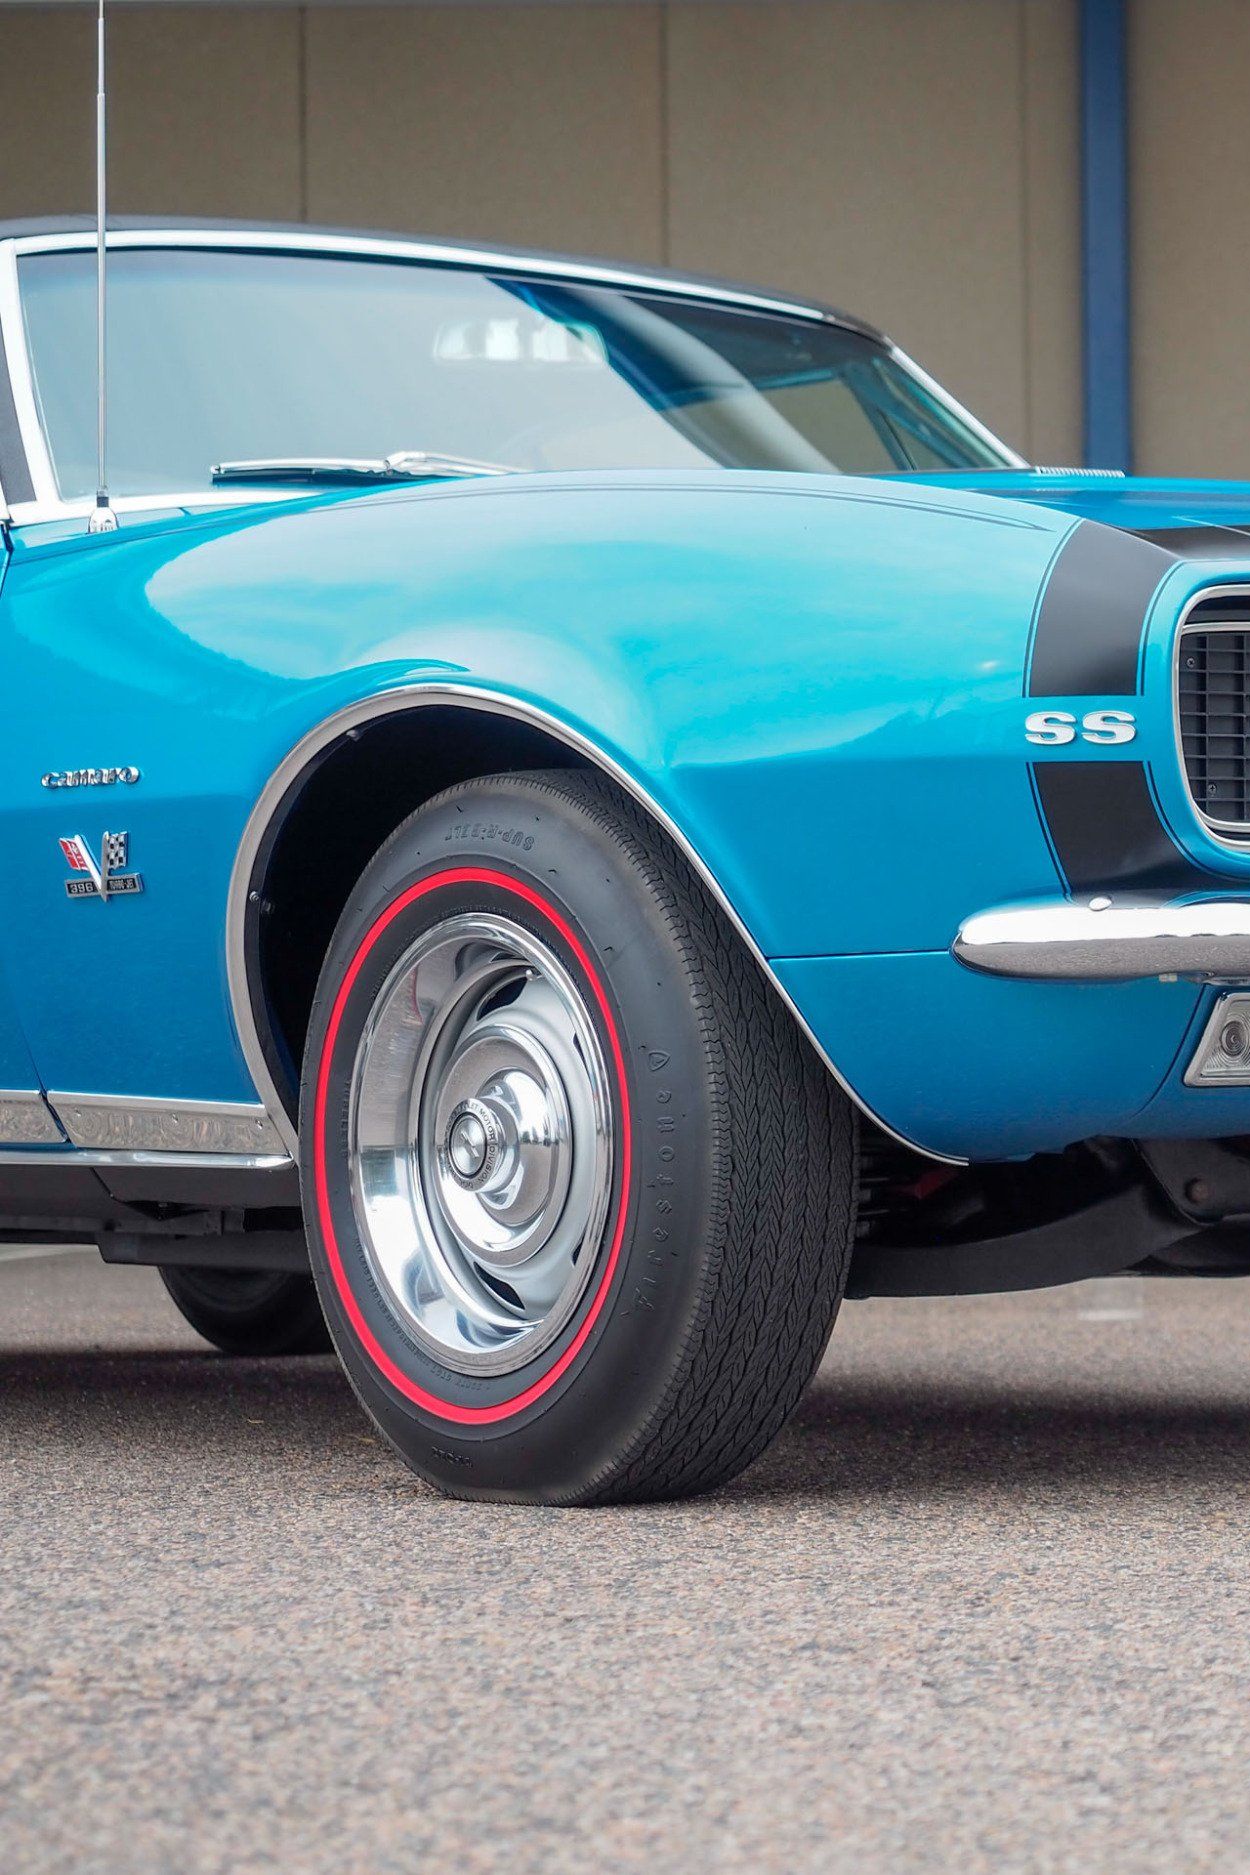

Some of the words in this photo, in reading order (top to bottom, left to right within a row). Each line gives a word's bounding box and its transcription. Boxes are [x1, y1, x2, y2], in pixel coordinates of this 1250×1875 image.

[1024, 710, 1137, 746] SS
[69, 882, 94, 894] 396
[479, 1108, 496, 1141] MOTOR
